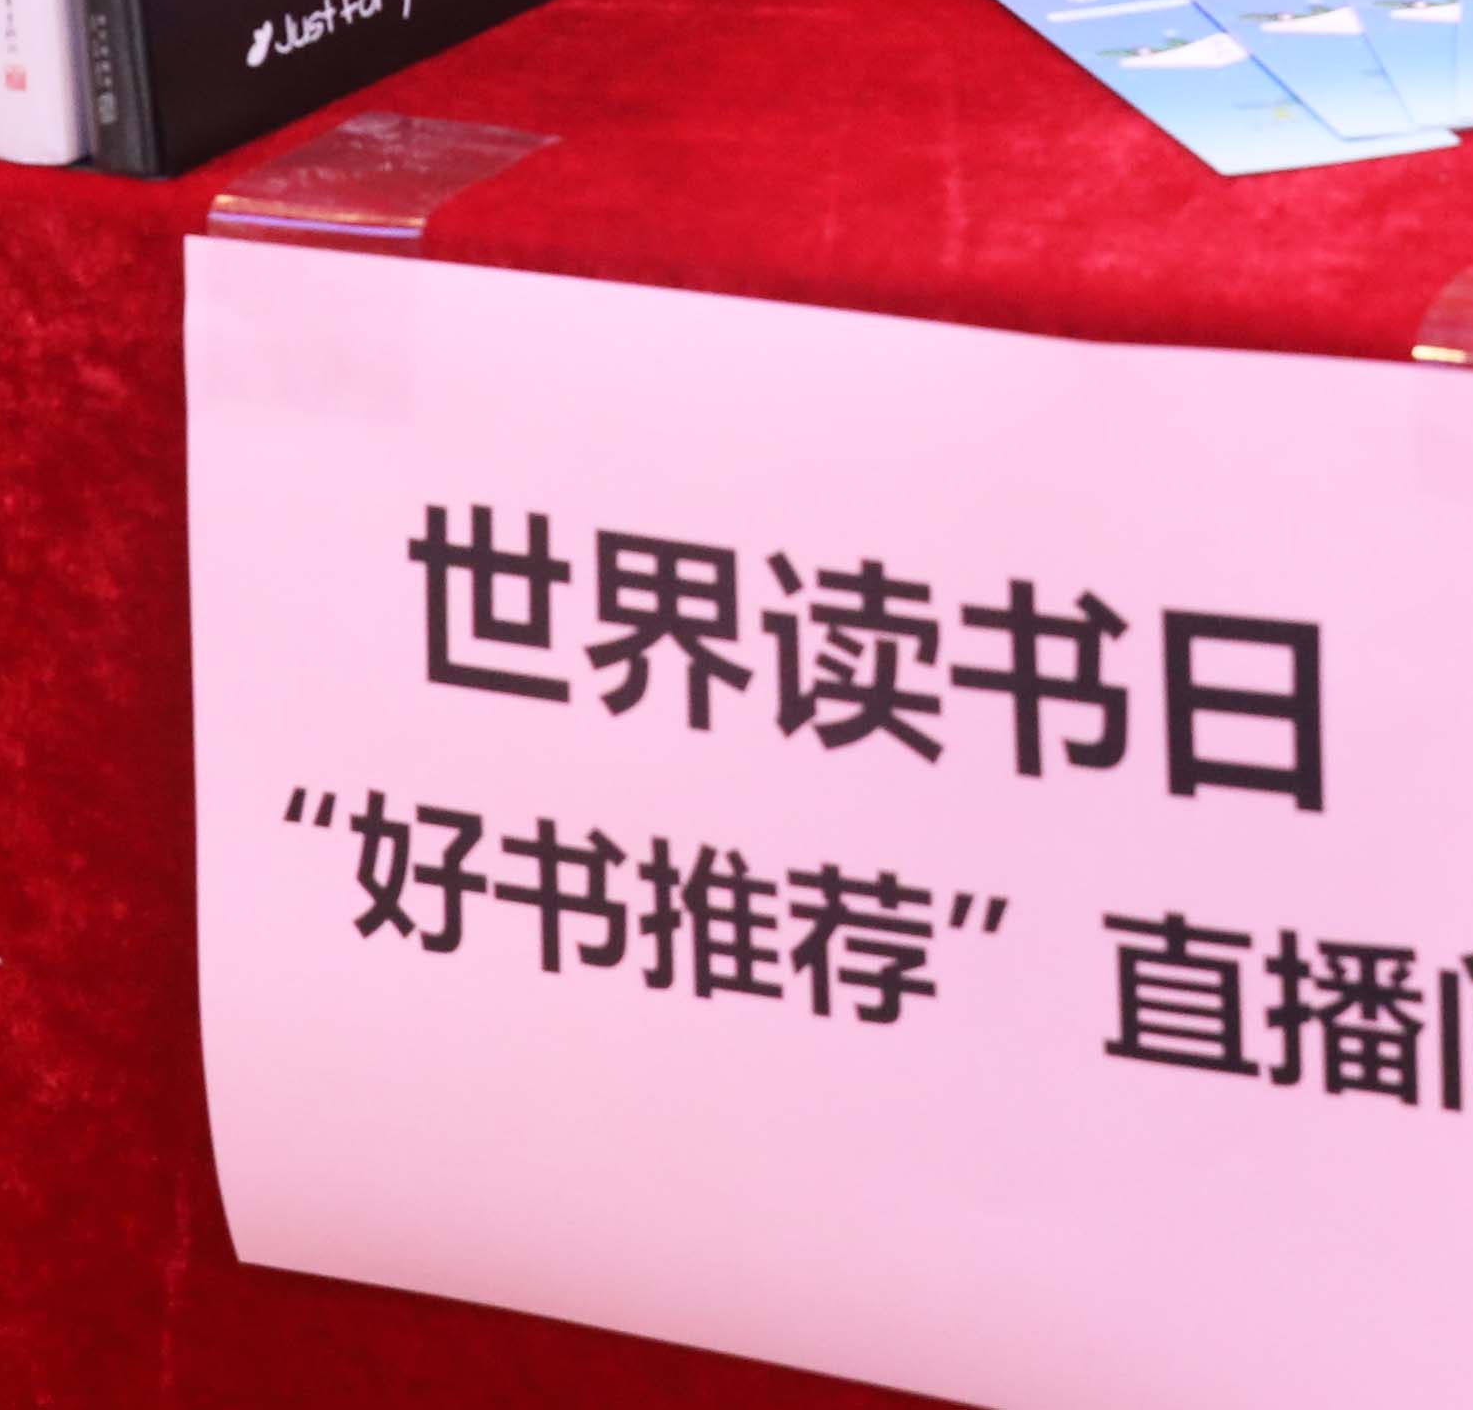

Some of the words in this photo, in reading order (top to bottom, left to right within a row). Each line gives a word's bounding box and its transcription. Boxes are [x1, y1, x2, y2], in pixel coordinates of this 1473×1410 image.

[274, 12, 336, 55] Just
[407, 503, 1328, 814] 世界读书日
[280, 785, 1011, 1026] “好书推荐”
